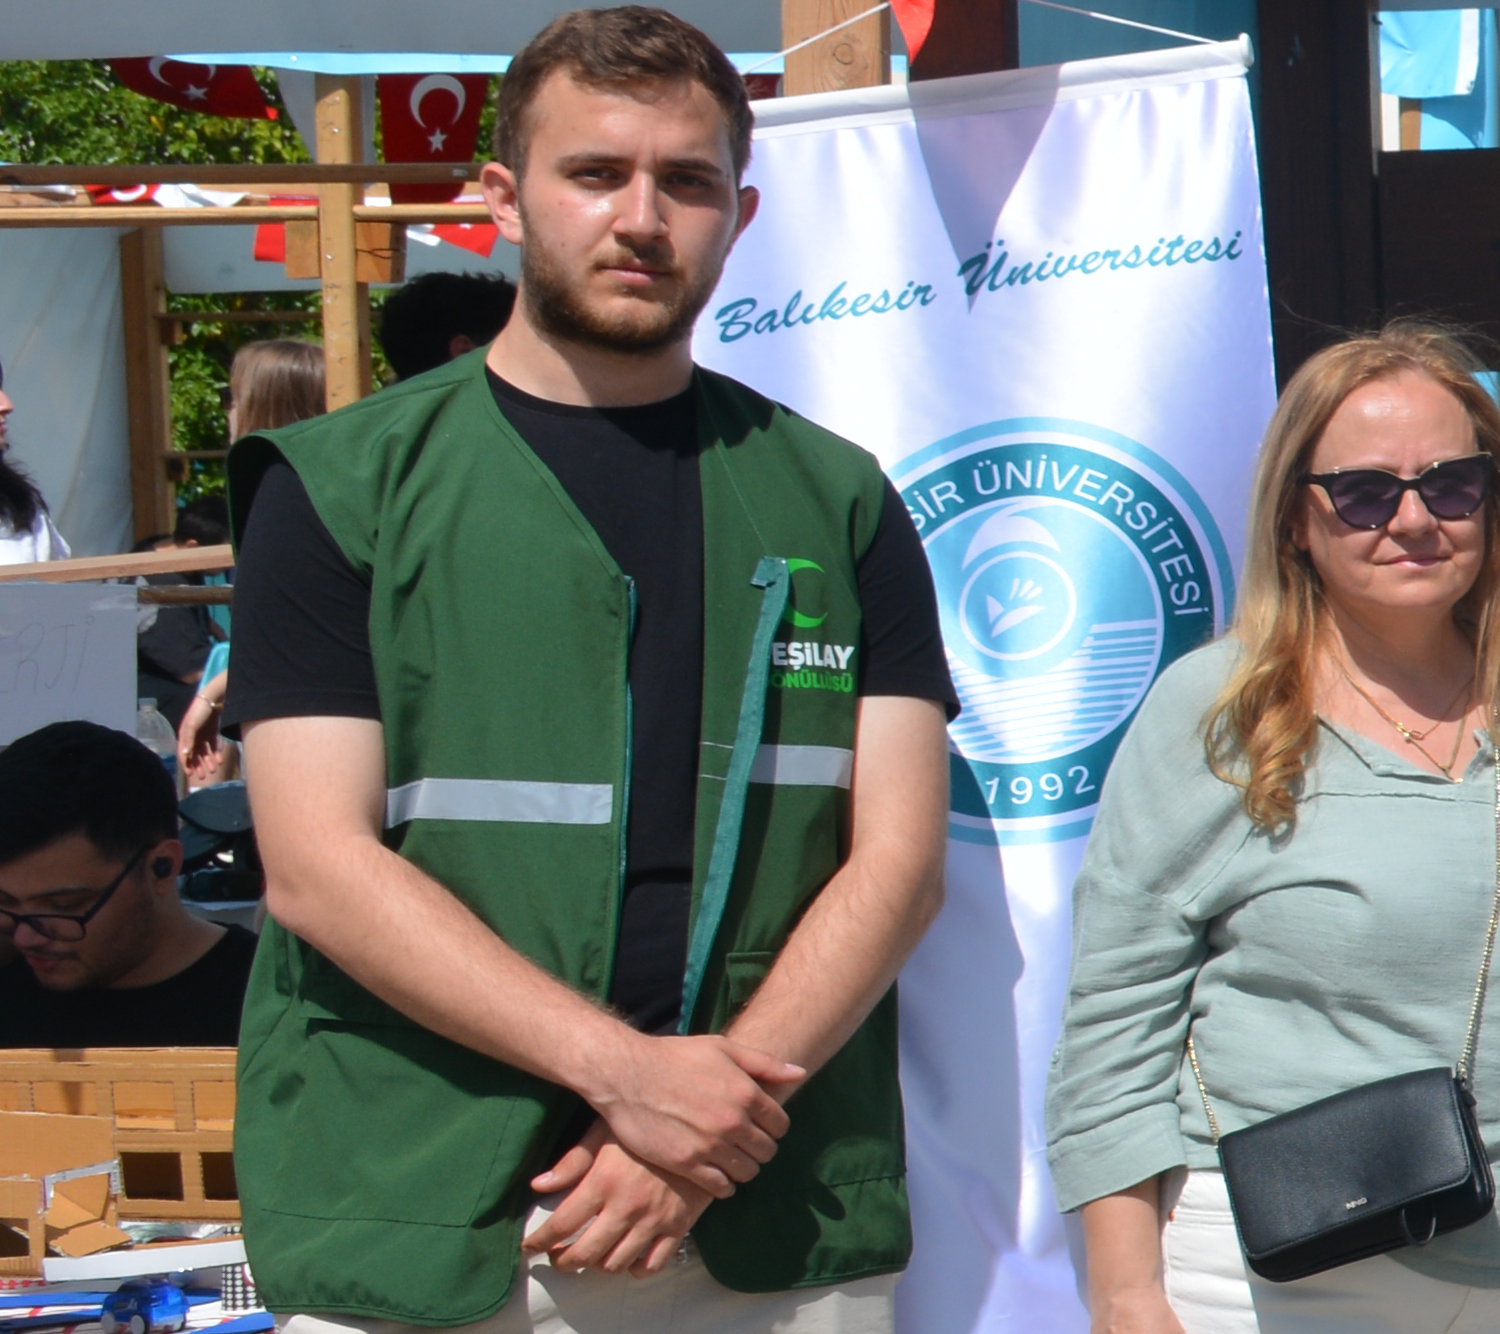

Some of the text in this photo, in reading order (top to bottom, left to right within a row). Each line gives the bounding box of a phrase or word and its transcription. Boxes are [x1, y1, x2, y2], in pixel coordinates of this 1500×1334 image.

[714, 230, 1243, 344] Balıkesir Üniversitesi
[971, 453, 1207, 618] ÜNİVERSİTESİ
[771, 641, 855, 671] EŞİLAY
[771, 668, 854, 694] ÖNÜLLÜSÜ
[985, 764, 1096, 806] 1992
